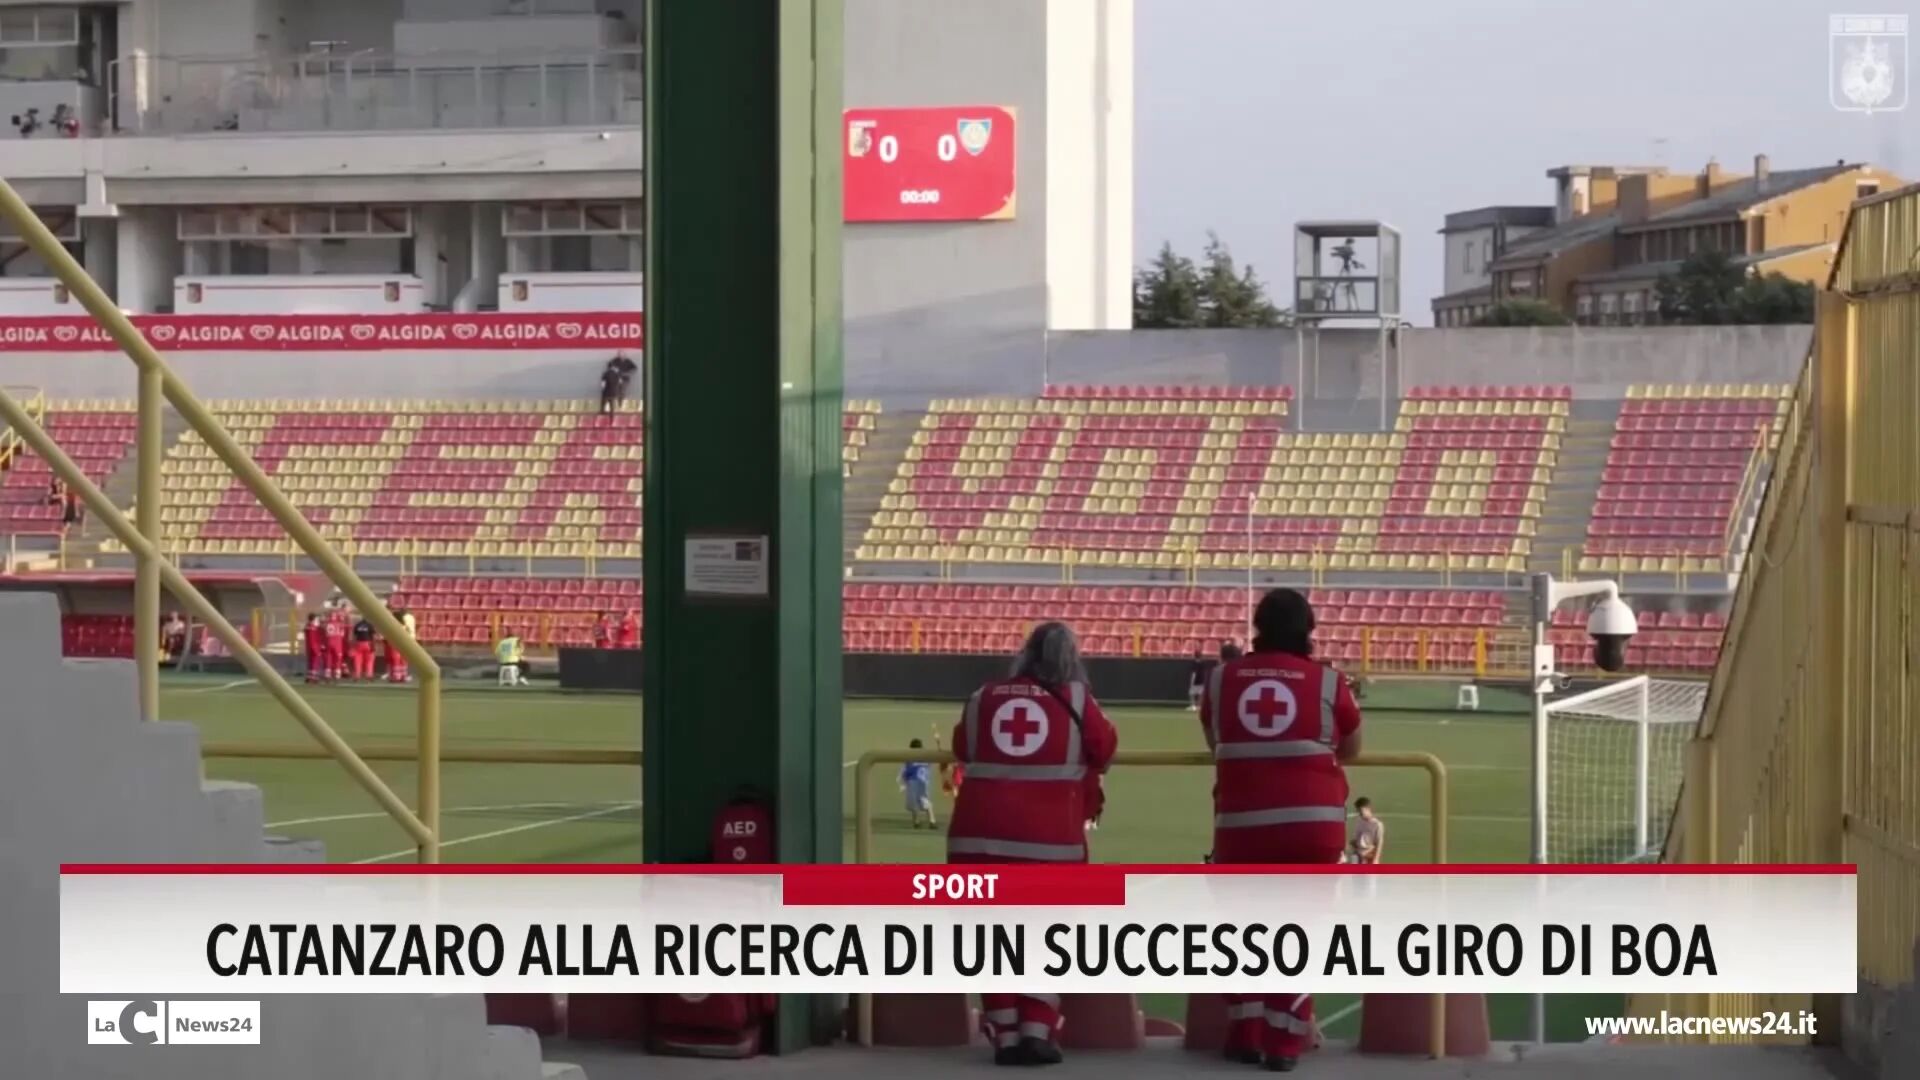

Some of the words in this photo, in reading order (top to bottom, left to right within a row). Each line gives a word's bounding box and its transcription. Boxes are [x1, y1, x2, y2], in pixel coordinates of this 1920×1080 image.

[879, 135, 899, 163] 0
[937, 134, 957, 162] 0
[178, 326, 243, 341] ALGIDA
[277, 325, 343, 340] ALGIDA
[378, 325, 446, 340] ALGIDA
[481, 324, 550, 339] ALGIDA
[584, 323, 641, 339] ALGID
[723, 820, 757, 835] AED
